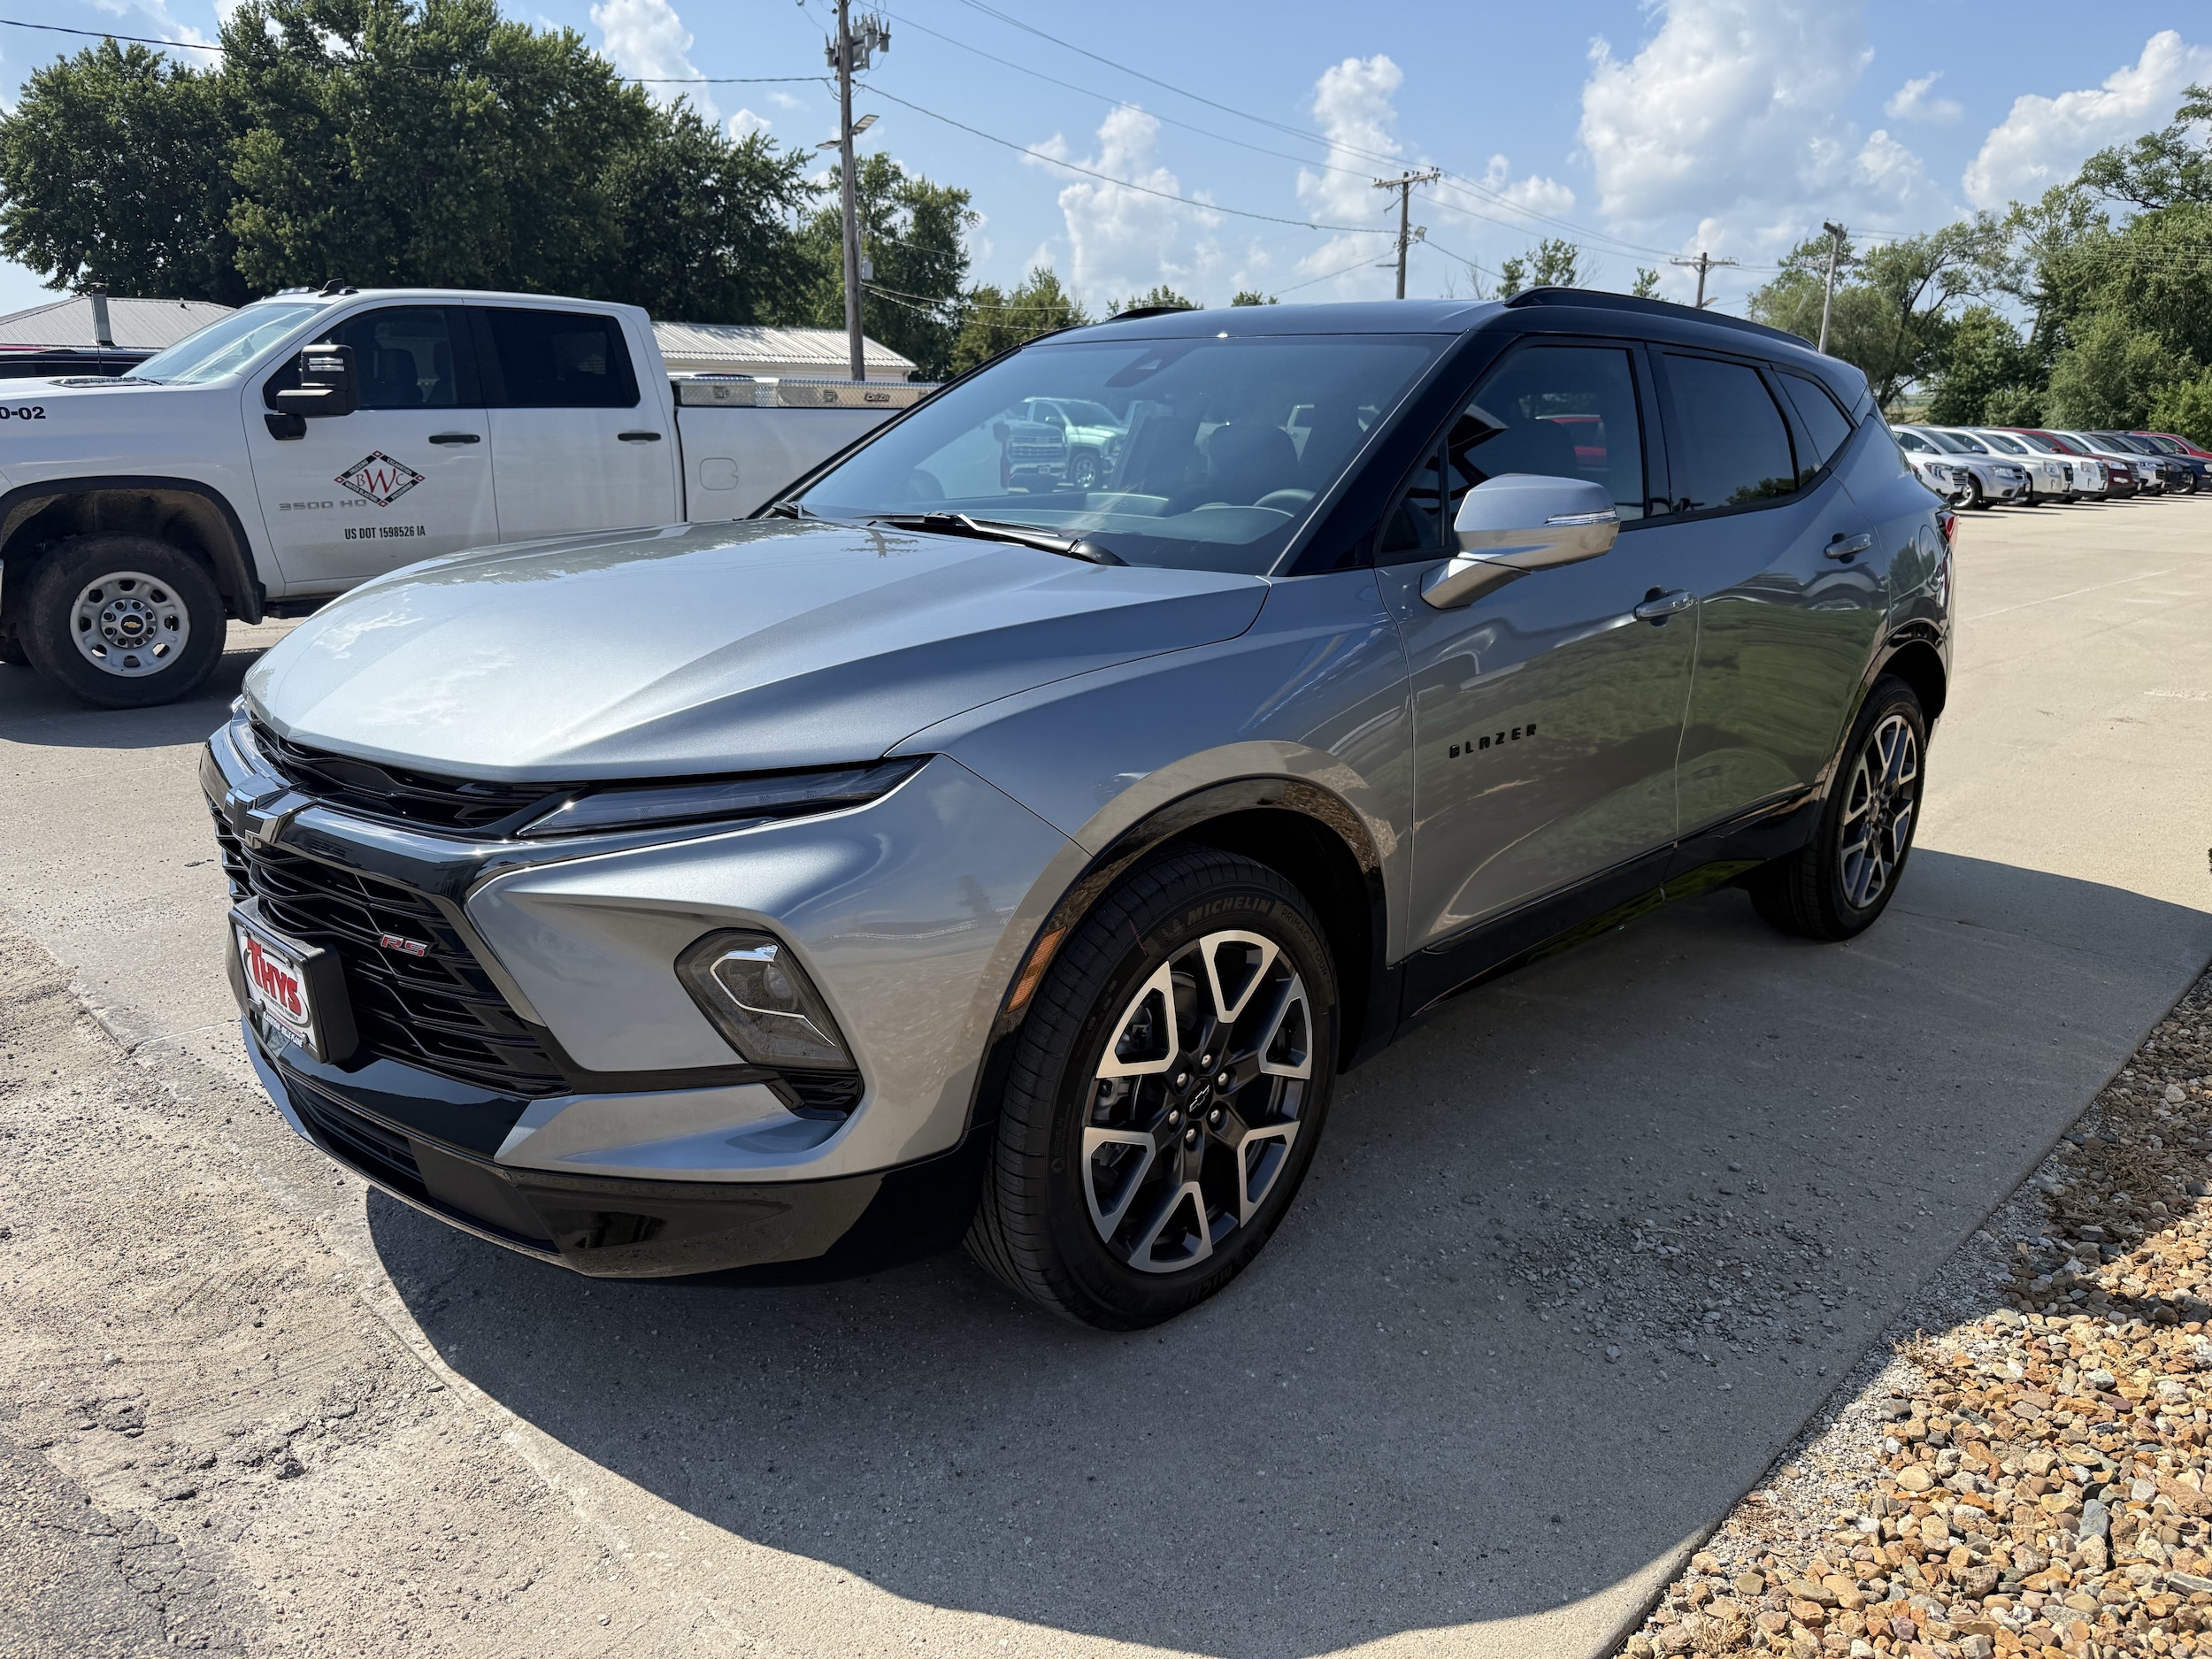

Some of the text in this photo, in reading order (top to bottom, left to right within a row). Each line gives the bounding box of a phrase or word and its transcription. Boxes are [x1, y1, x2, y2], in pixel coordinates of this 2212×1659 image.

[387, 457, 413, 476] EXCAVATION
[279, 499, 367, 511] 3500 HD
[344, 526, 426, 540] US DOT 1598526 IA
[1449, 724, 1537, 759] BLAZER
[380, 933, 428, 957] RS
[1187, 896, 1328, 977] MICHELIN PRIMACY TOUR
[247, 937, 303, 1017] THYS
